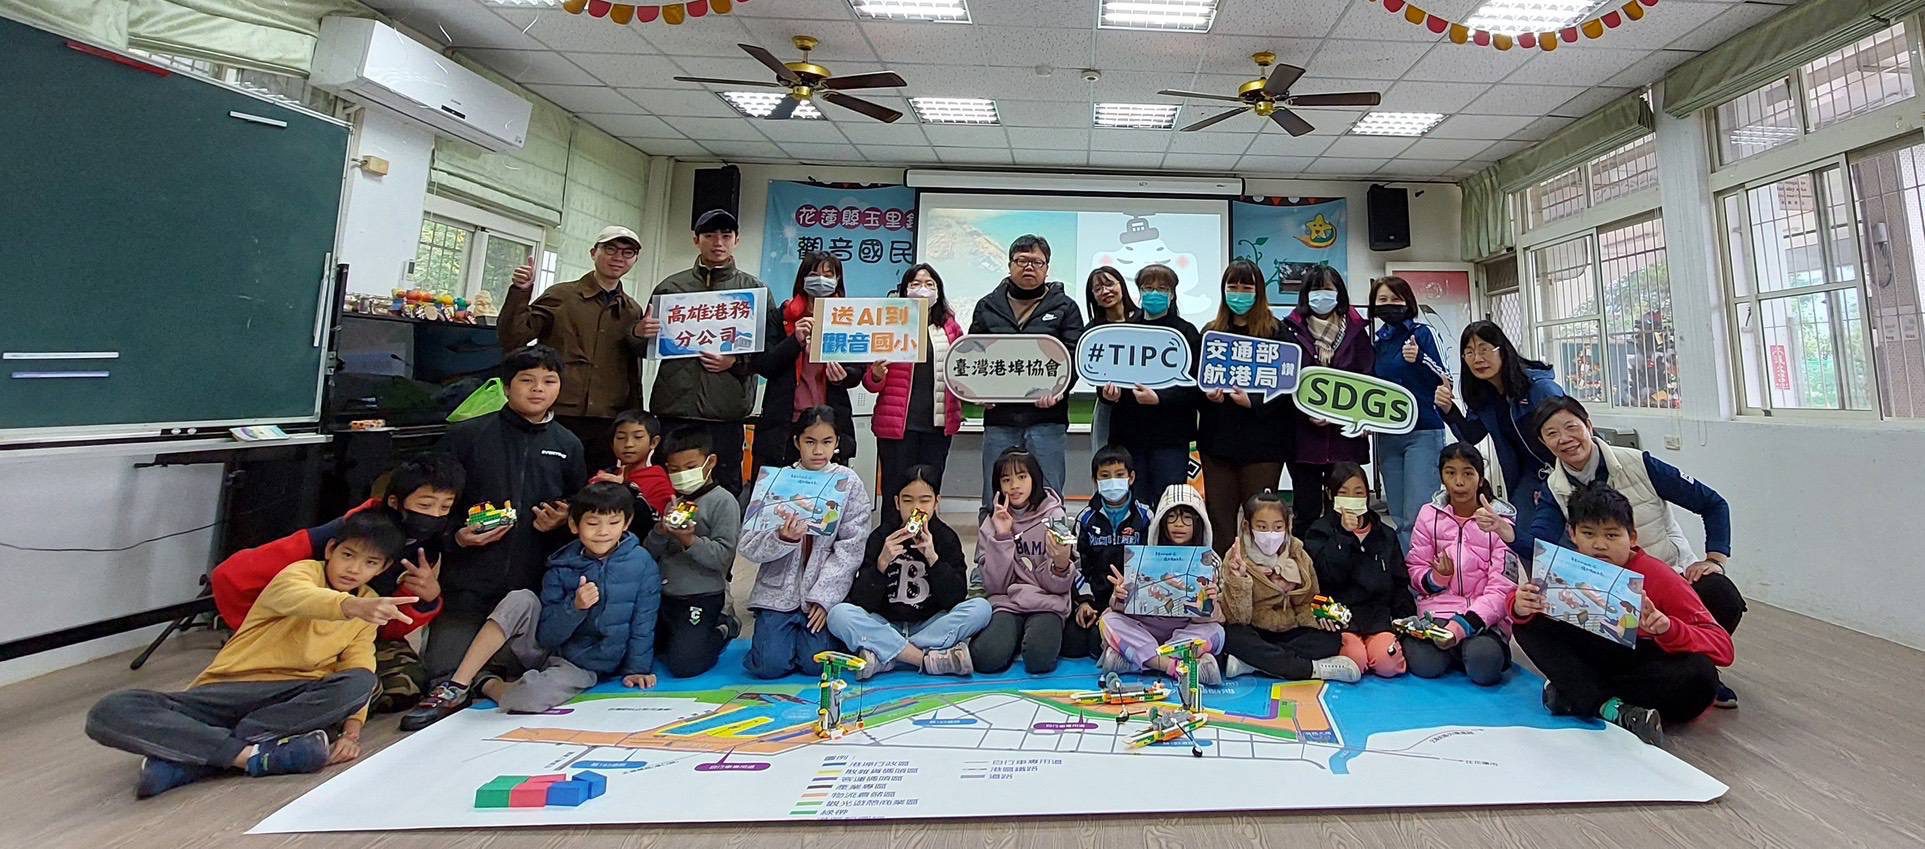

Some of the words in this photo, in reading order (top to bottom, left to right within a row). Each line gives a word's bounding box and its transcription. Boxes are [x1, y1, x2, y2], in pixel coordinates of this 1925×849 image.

[668, 301, 751, 324] 高雄港務
[831, 306, 911, 326] 送AI到
[675, 327, 737, 347] 分公司
[822, 332, 917, 355] 觀音國小
[1088, 344, 1178, 368] #TIPC
[1206, 339, 1280, 364] 交通部
[953, 358, 1061, 377] 臺灣港埠協會
[1203, 363, 1278, 388] 航港局
[1308, 377, 1408, 422] SDGs
